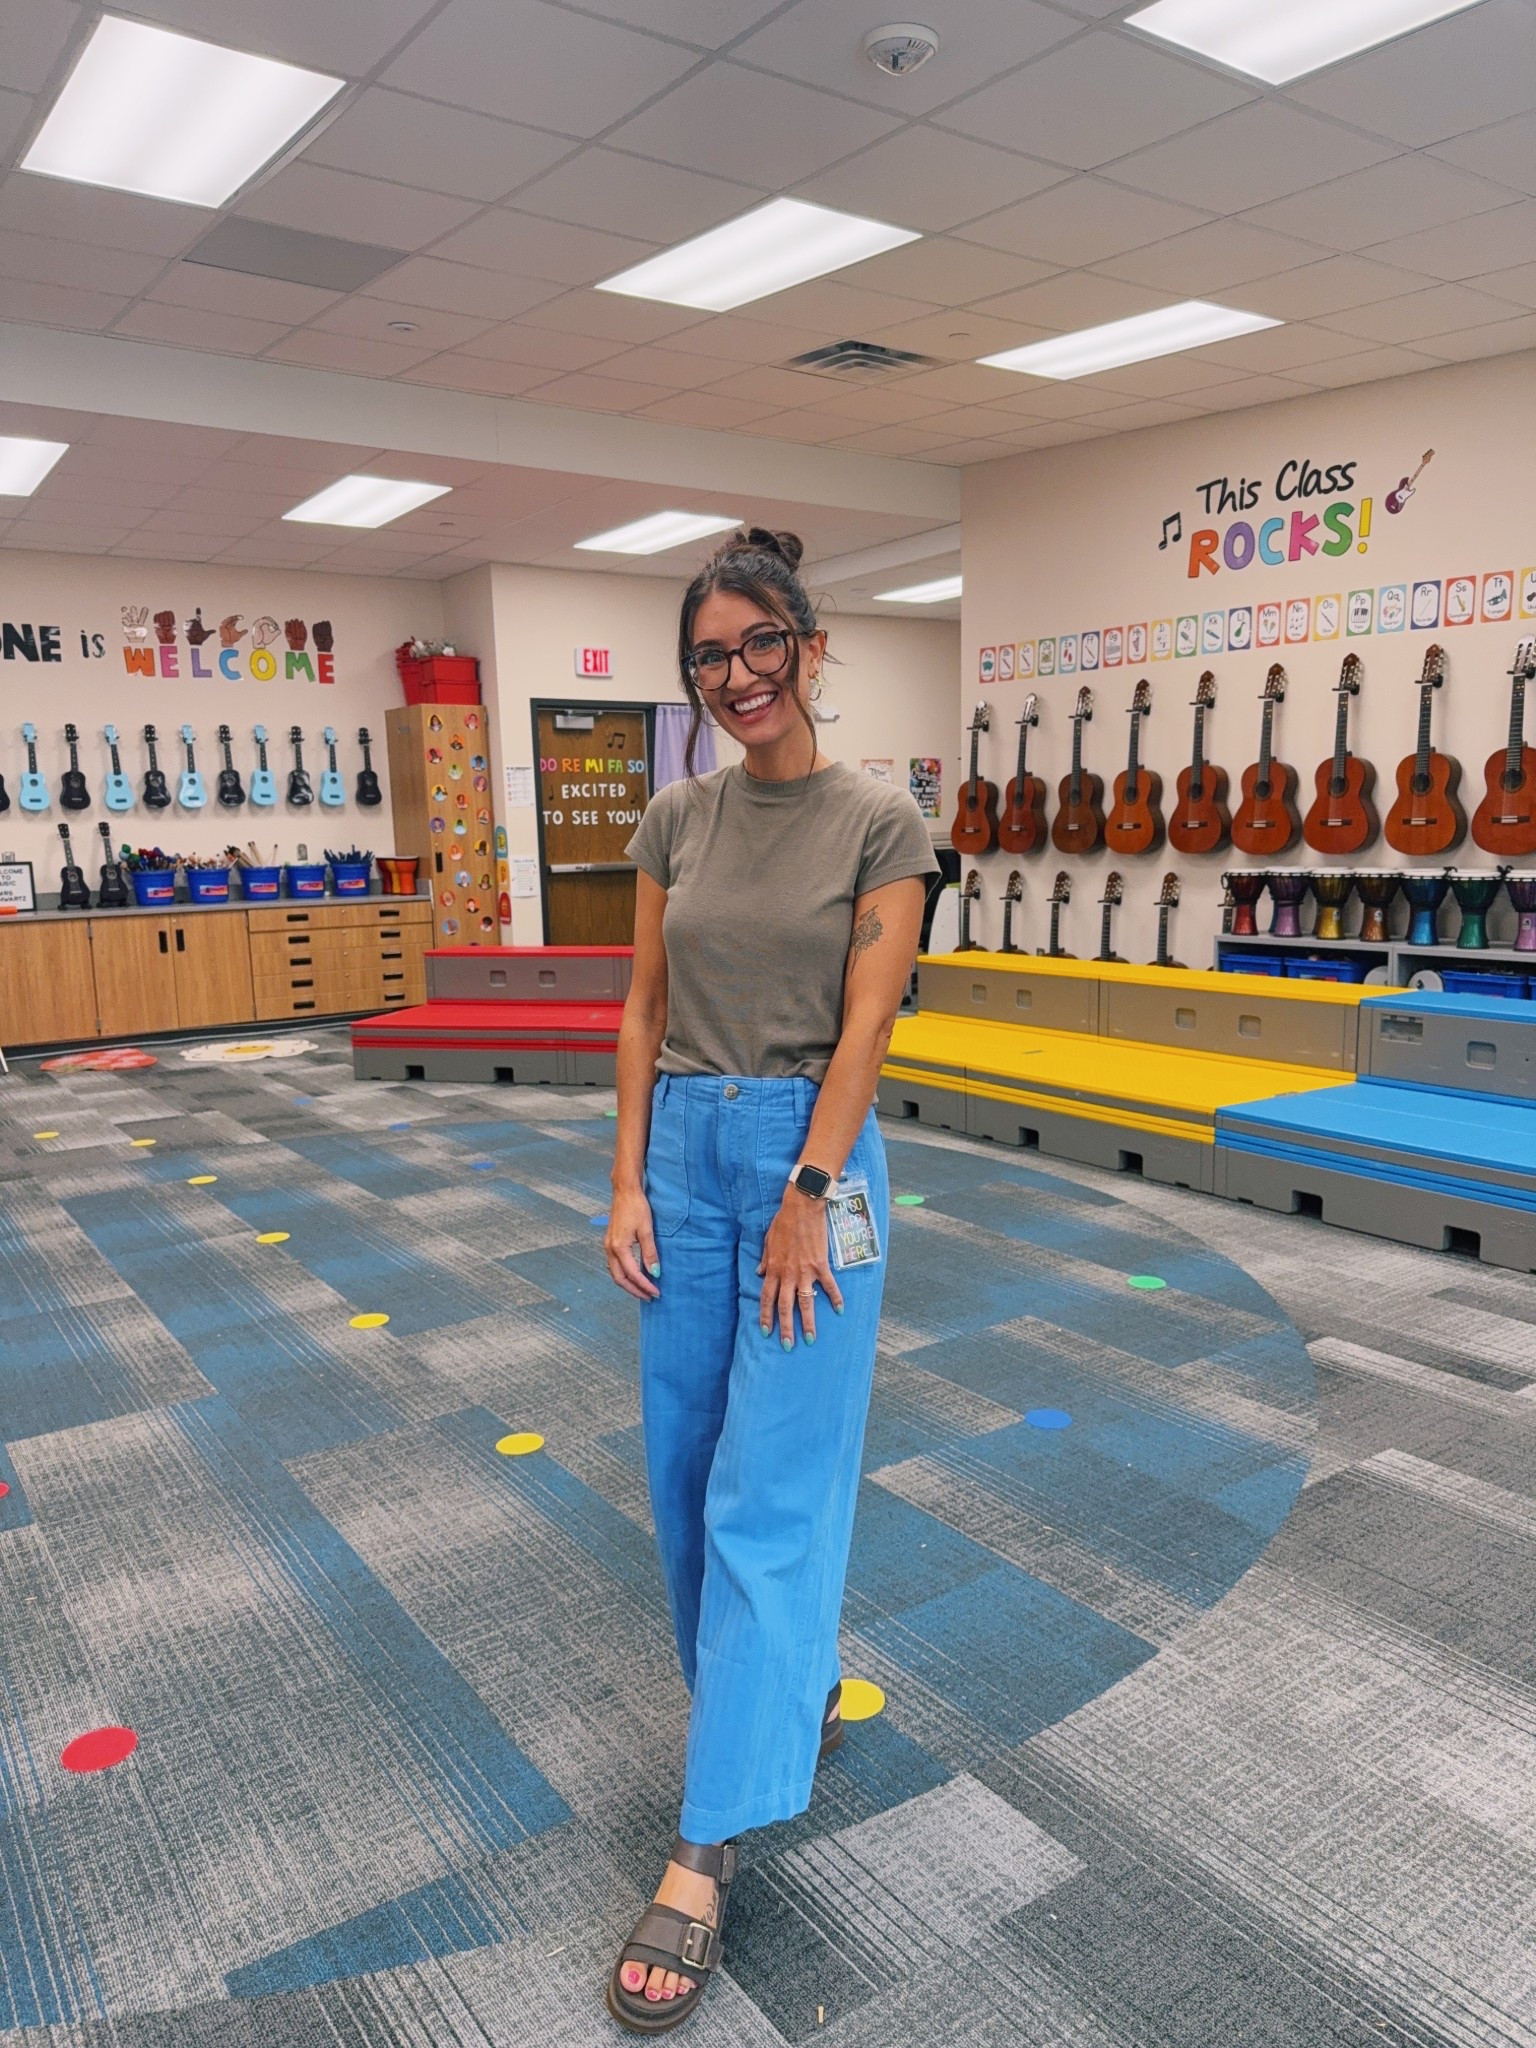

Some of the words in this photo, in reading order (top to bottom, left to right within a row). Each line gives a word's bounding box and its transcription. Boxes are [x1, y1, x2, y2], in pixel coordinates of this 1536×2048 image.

[1196, 477, 1262, 515] This
[1276, 459, 1357, 501] Class
[1188, 497, 1372, 578] ROCKS!
[1456, 582, 1468, 593] Ss
[1492, 577, 1504, 588] Tt
[1387, 590, 1401, 602] Qq
[1420, 586, 1433, 597] Rr
[1292, 604, 1303, 613] Nn
[1322, 599, 1334, 609] Oo
[1355, 595, 1366, 606] Pp
[1262, 608, 1277, 617] Mm
[0, 623, 62, 662] NE
[80, 630, 105, 658] is
[123, 646, 335, 684] WELCOME
[583, 649, 609, 673] EXIT
[540, 758, 558, 772] DO
[562, 758, 580, 773] RE
[585, 758, 604, 773] MI
[608, 759, 624, 773] FA
[627, 760, 645, 773] SO
[561, 783, 626, 799] EXCITED
[543, 810, 564, 825] TO
[571, 810, 599, 825] SEE
[606, 809, 641, 825] YOU!
[832, 1201, 848, 1217] I'M
[848, 1197, 862, 1212] SO
[836, 1211, 867, 1231] HAPPY
[840, 1226, 874, 1246] YOU'RE
[844, 1243, 873, 1262] HERE
